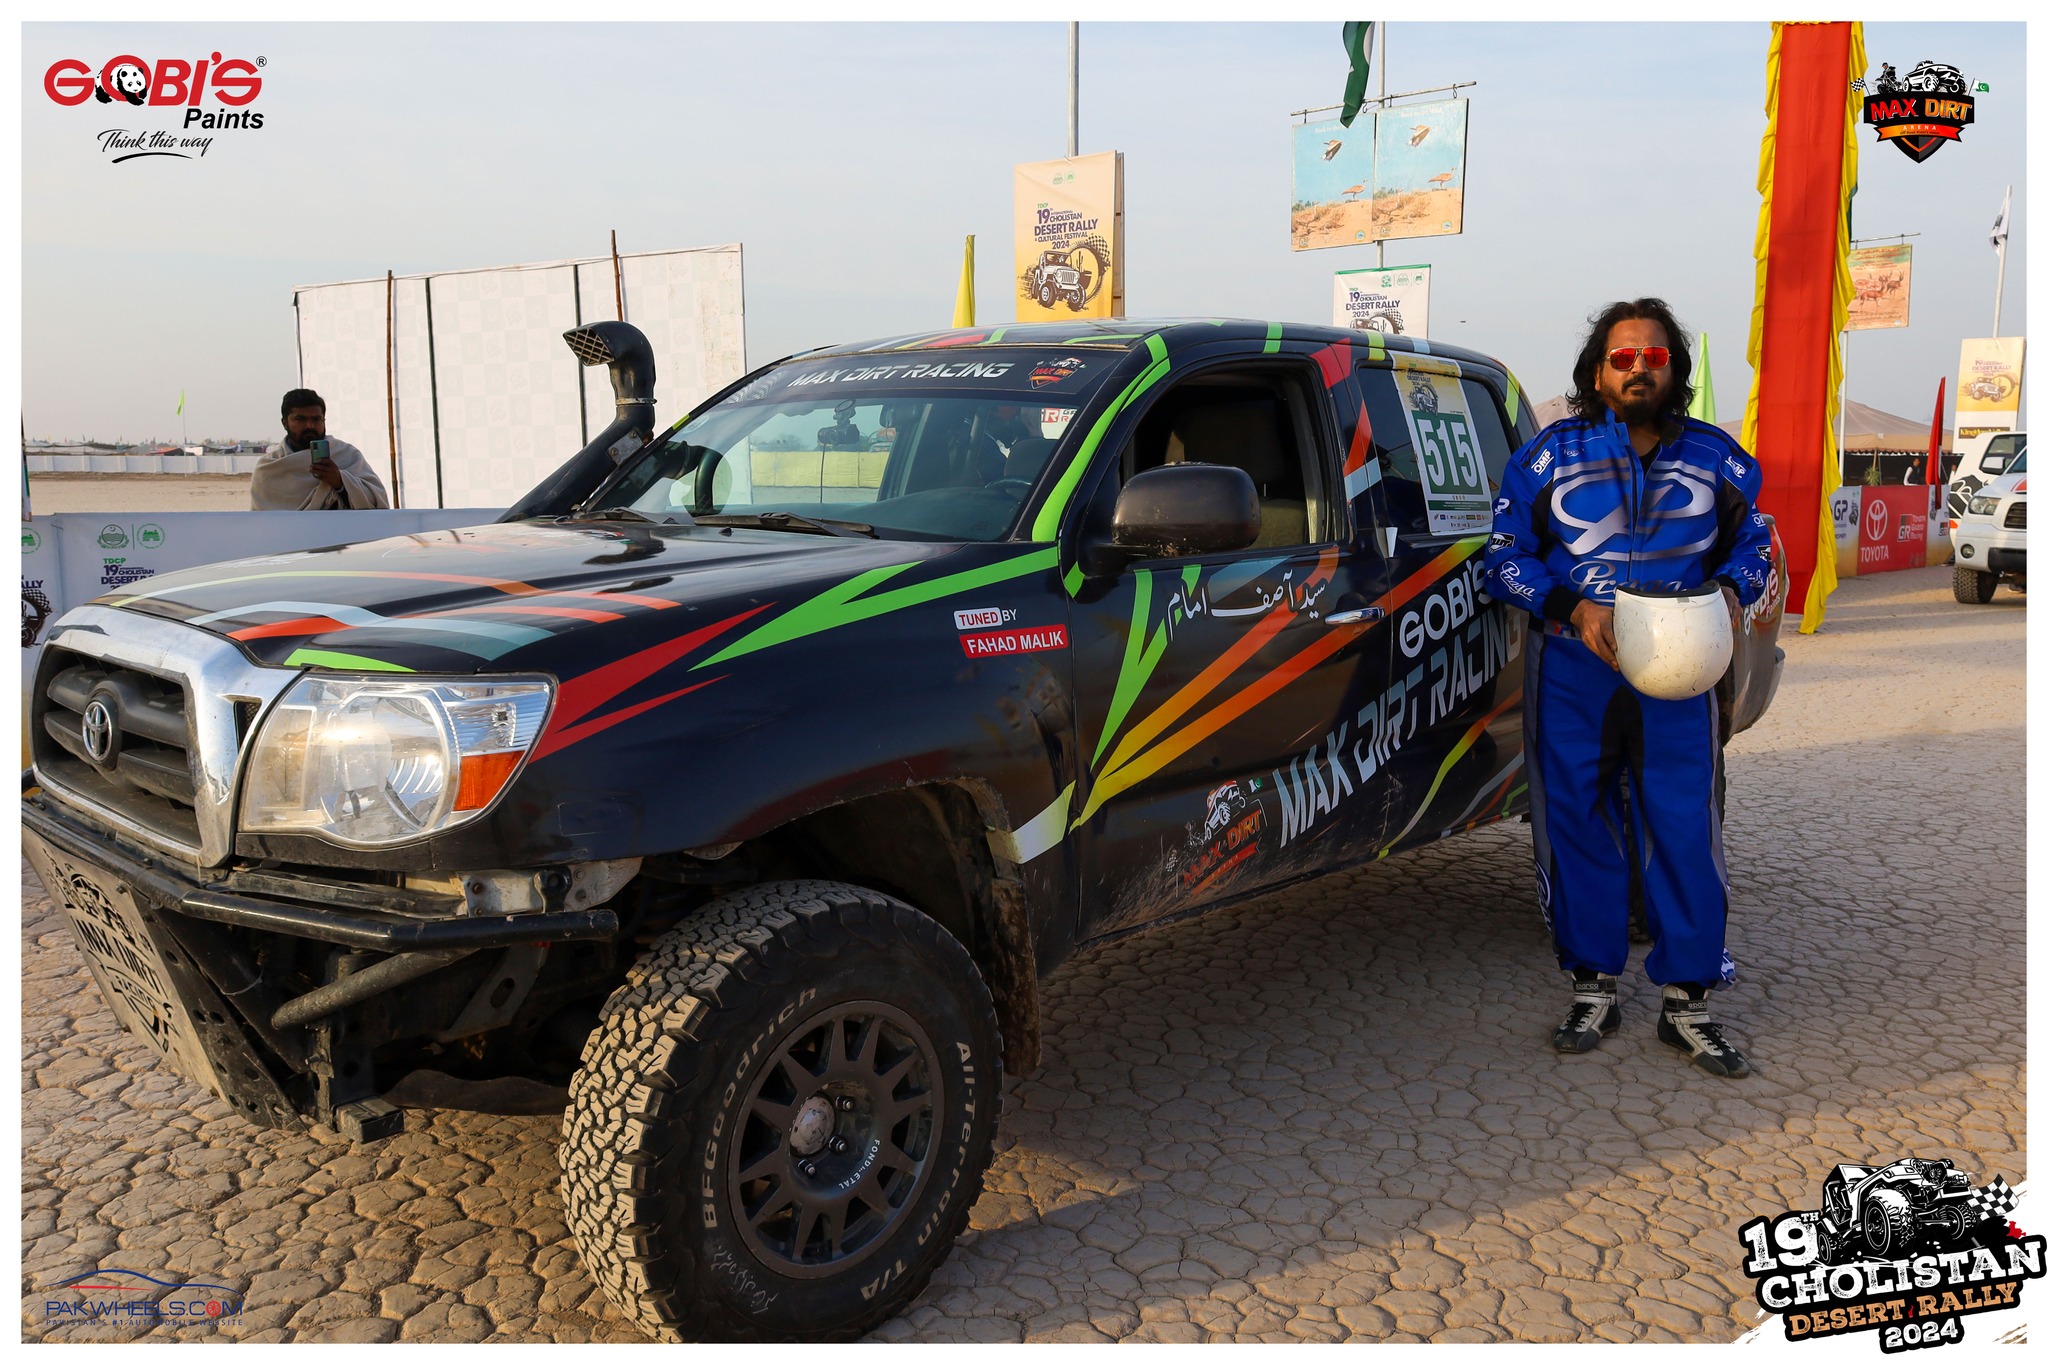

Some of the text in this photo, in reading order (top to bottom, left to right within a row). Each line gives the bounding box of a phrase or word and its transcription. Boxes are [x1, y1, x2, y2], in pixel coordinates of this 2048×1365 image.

[1034, 219, 1099, 236] DESERT RALLY
[1050, 212, 1082, 222] CHOLISTAN
[1038, 234, 1063, 243] CULTURAL
[1064, 231, 1088, 240] FESTIVAL
[1052, 240, 1070, 250] 2024
[1346, 300, 1400, 310] DESERT RALLY
[787, 362, 1015, 387] MAX DIRT RACING
[1417, 418, 1479, 488] 515
[1533, 450, 1552, 474] OMP
[1834, 499, 1848, 521] GP
[1898, 525, 1911, 540] GR
[1861, 545, 1889, 562] TOYOTA
[101, 576, 139, 585] DESERT
[1500, 561, 1536, 597] Praga
[959, 609, 1017, 626] TUNED BY
[967, 631, 1064, 654] FAHAD MALIK
[1272, 609, 1522, 849] MAX DIRT RACING
[1226, 809, 1262, 850] DIRT
[702, 987, 817, 1228] BFGoodrich
[860, 1042, 976, 1300] All-Terrain T/A
